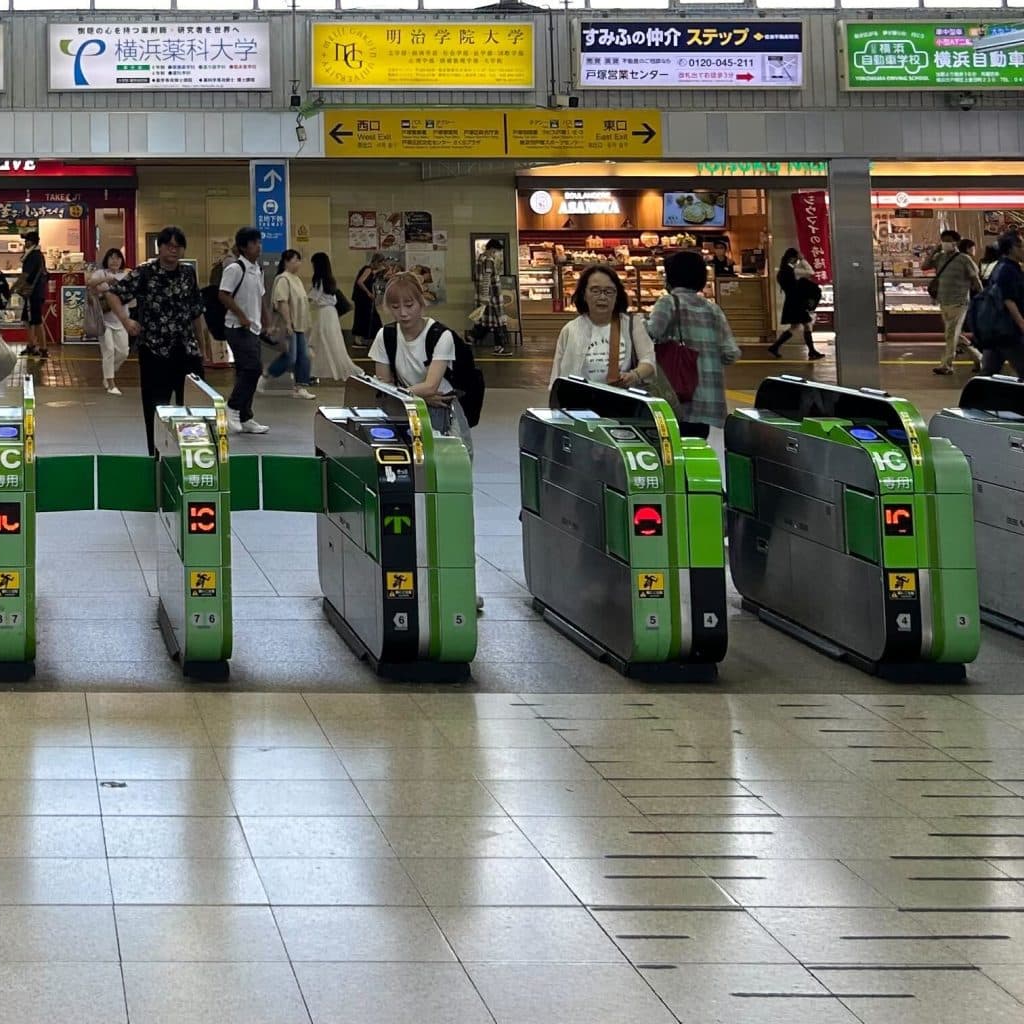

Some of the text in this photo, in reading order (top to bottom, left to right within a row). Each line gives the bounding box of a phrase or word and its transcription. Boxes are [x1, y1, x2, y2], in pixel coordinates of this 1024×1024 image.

[386, 29, 525, 45] 明治学院大学
[582, 28, 682, 47] すみふの仲介
[687, 27, 750, 46] ステップ
[115, 38, 257, 62] 横浜薬科大学
[688, 59, 754, 67] 0120-045-211
[934, 50, 1024, 68] 横浜自動車
[586, 69, 669, 81] 戸塚営業センター
[357, 120, 381, 132] 西口
[604, 120, 628, 131] 東口
[185, 448, 215, 469] IC
[626, 451, 659, 471] IC
[872, 450, 908, 471] IC
[188, 474, 214, 487] 専用
[632, 476, 659, 489] 専用
[11, 614, 18, 624] 7
[194, 614, 200, 624] 7
[208, 614, 215, 624] 6
[398, 615, 405, 625] 6
[456, 615, 462, 624] 5
[649, 615, 656, 625] 5
[706, 615, 713, 625] 4
[901, 616, 908, 625] 4
[959, 616, 966, 625] 3
